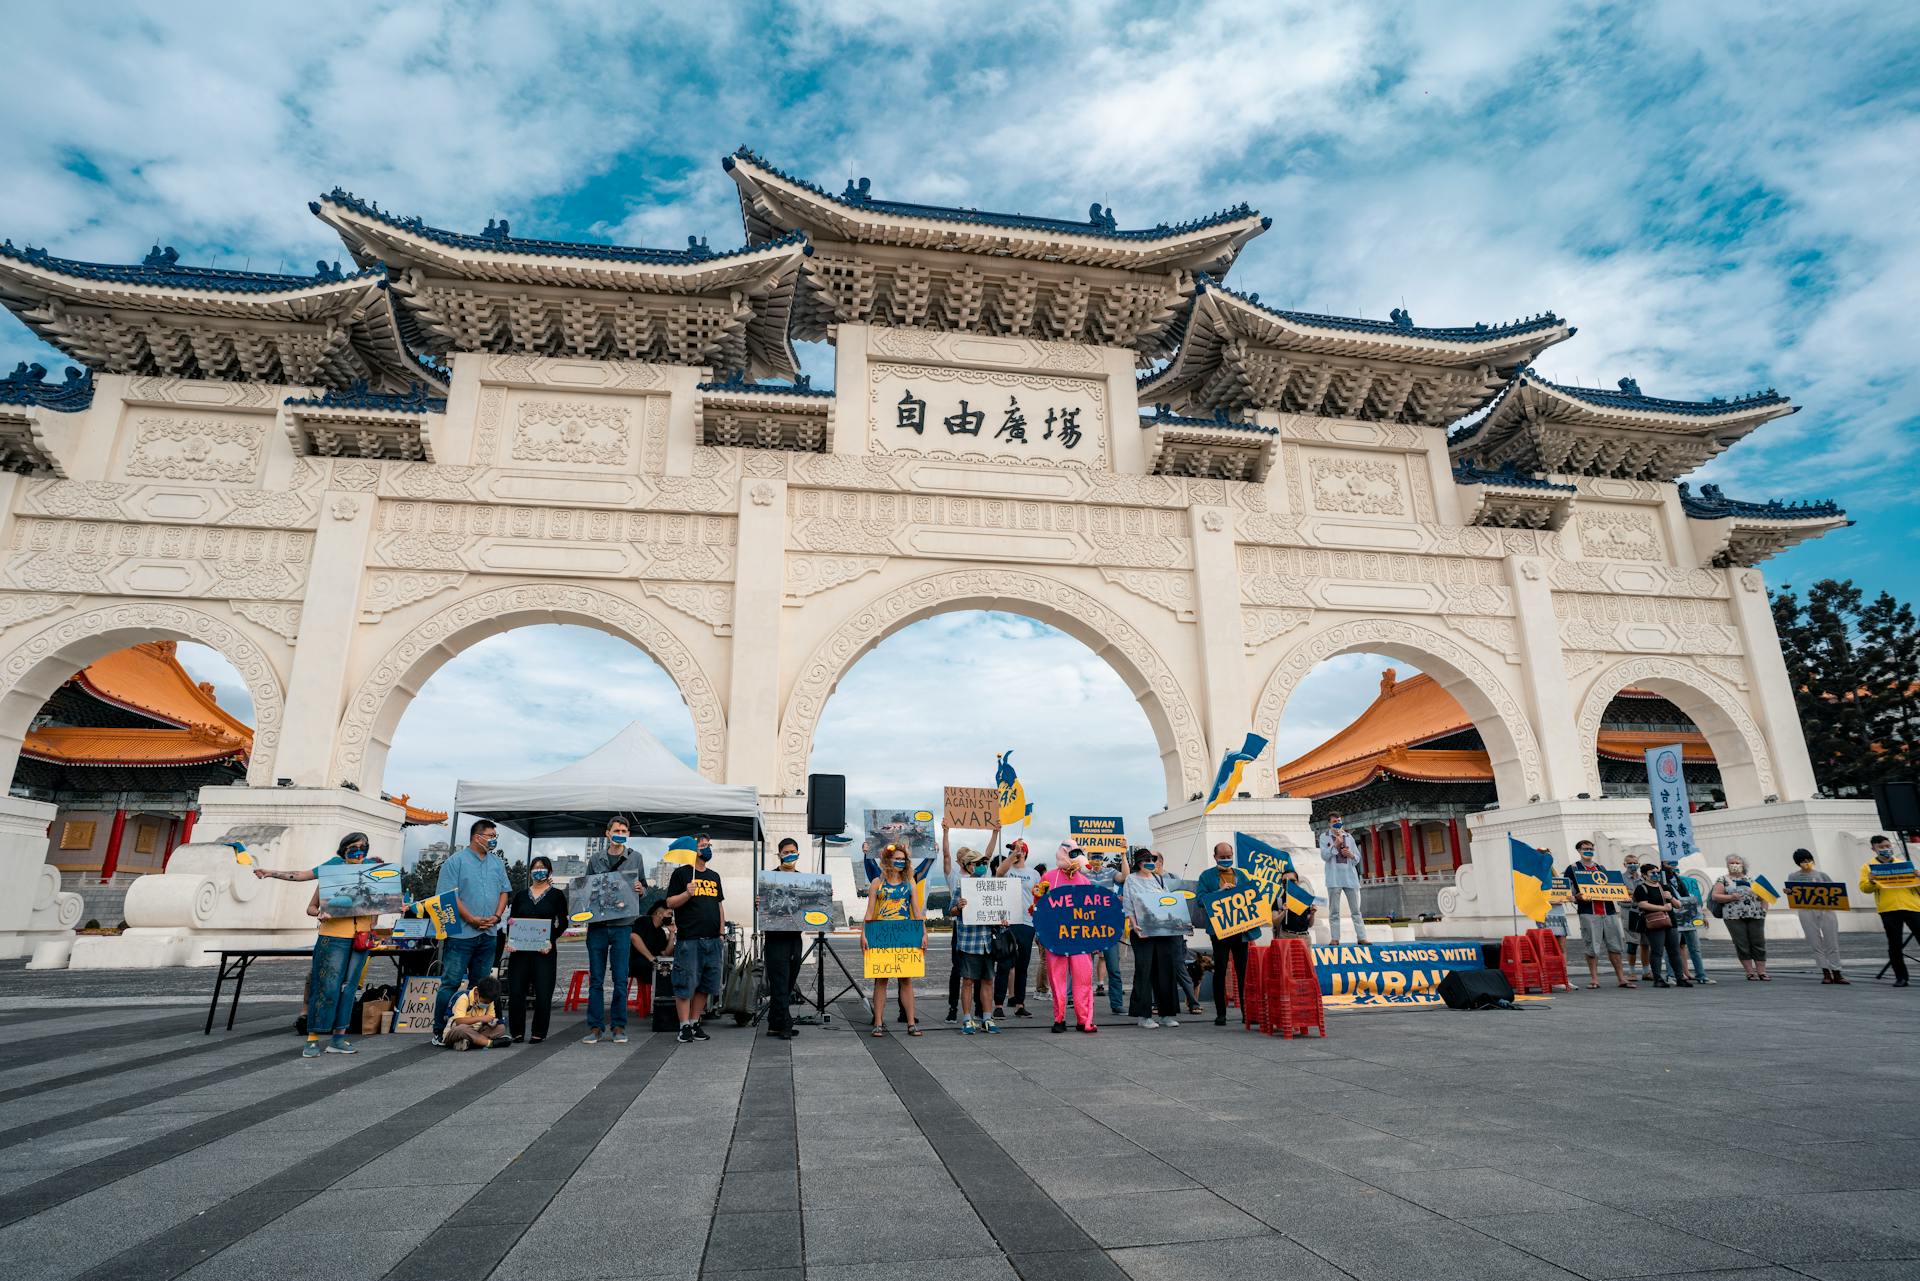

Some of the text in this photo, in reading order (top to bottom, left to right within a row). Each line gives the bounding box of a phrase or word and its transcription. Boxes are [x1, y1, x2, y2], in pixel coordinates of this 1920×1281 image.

[945, 787, 999, 800] RUSSIANS
[945, 798, 992, 810] AGAINST
[949, 811, 997, 827] WAR
[1078, 820, 1115, 829] TAIWAN
[1075, 838, 1122, 847] UKRAINE
[976, 880, 1008, 892] 俄羅斯
[1581, 887, 1625, 895] TAIWAN
[1792, 886, 1843, 897] STOP
[1047, 894, 1111, 909] WE ARE
[1211, 889, 1256, 917] STOP
[1793, 895, 1840, 906] WAR
[1216, 904, 1260, 930] WAR
[1058, 925, 1115, 939] AFRAID
[894, 953, 922, 964] IRPIN
[1311, 947, 1477, 967] IWAN STANDS WITH
[872, 963, 903, 975] BUCHA
[410, 981, 439, 995] WE'R
[401, 999, 434, 1014] UKRAI
